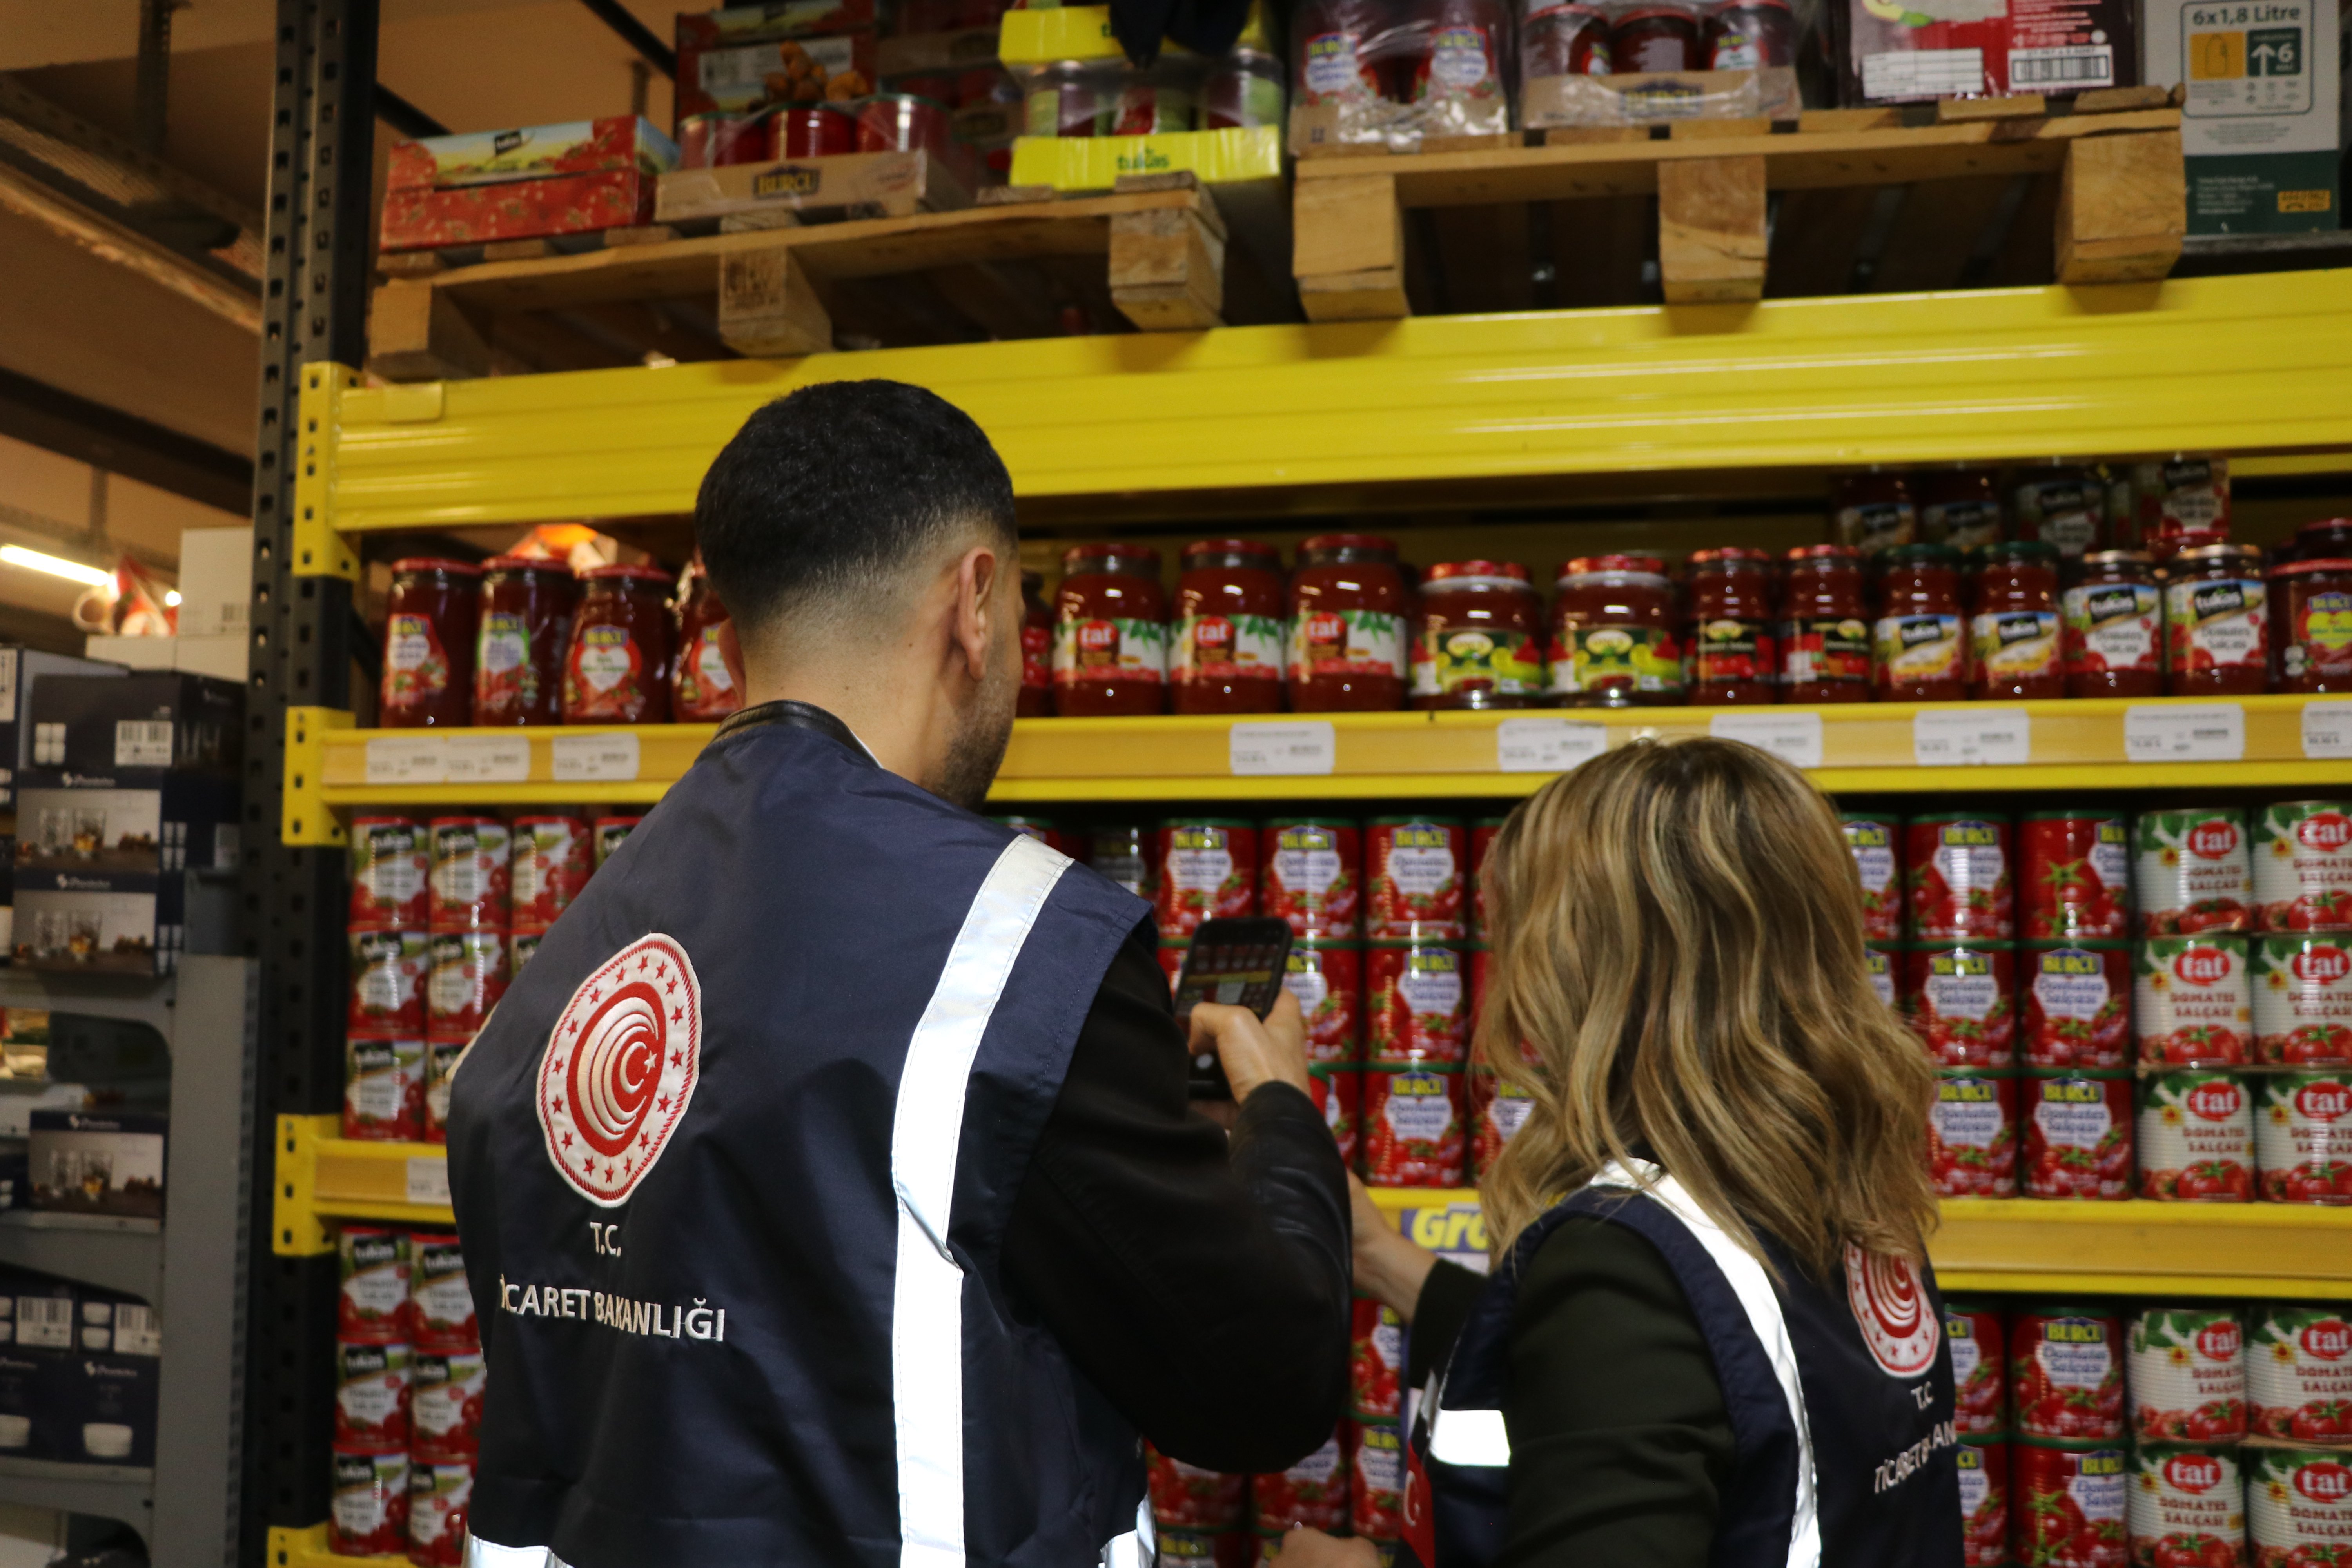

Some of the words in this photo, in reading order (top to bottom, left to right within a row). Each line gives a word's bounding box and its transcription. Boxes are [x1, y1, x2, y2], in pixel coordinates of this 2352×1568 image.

[2193, 8, 2248, 25] 6x1,8
[2254, 5, 2300, 22] Litre
[2277, 42, 2294, 64] 6
[590, 1221, 622, 1257] T.C.
[594, 1291, 725, 1342] BAKANLIĞI
